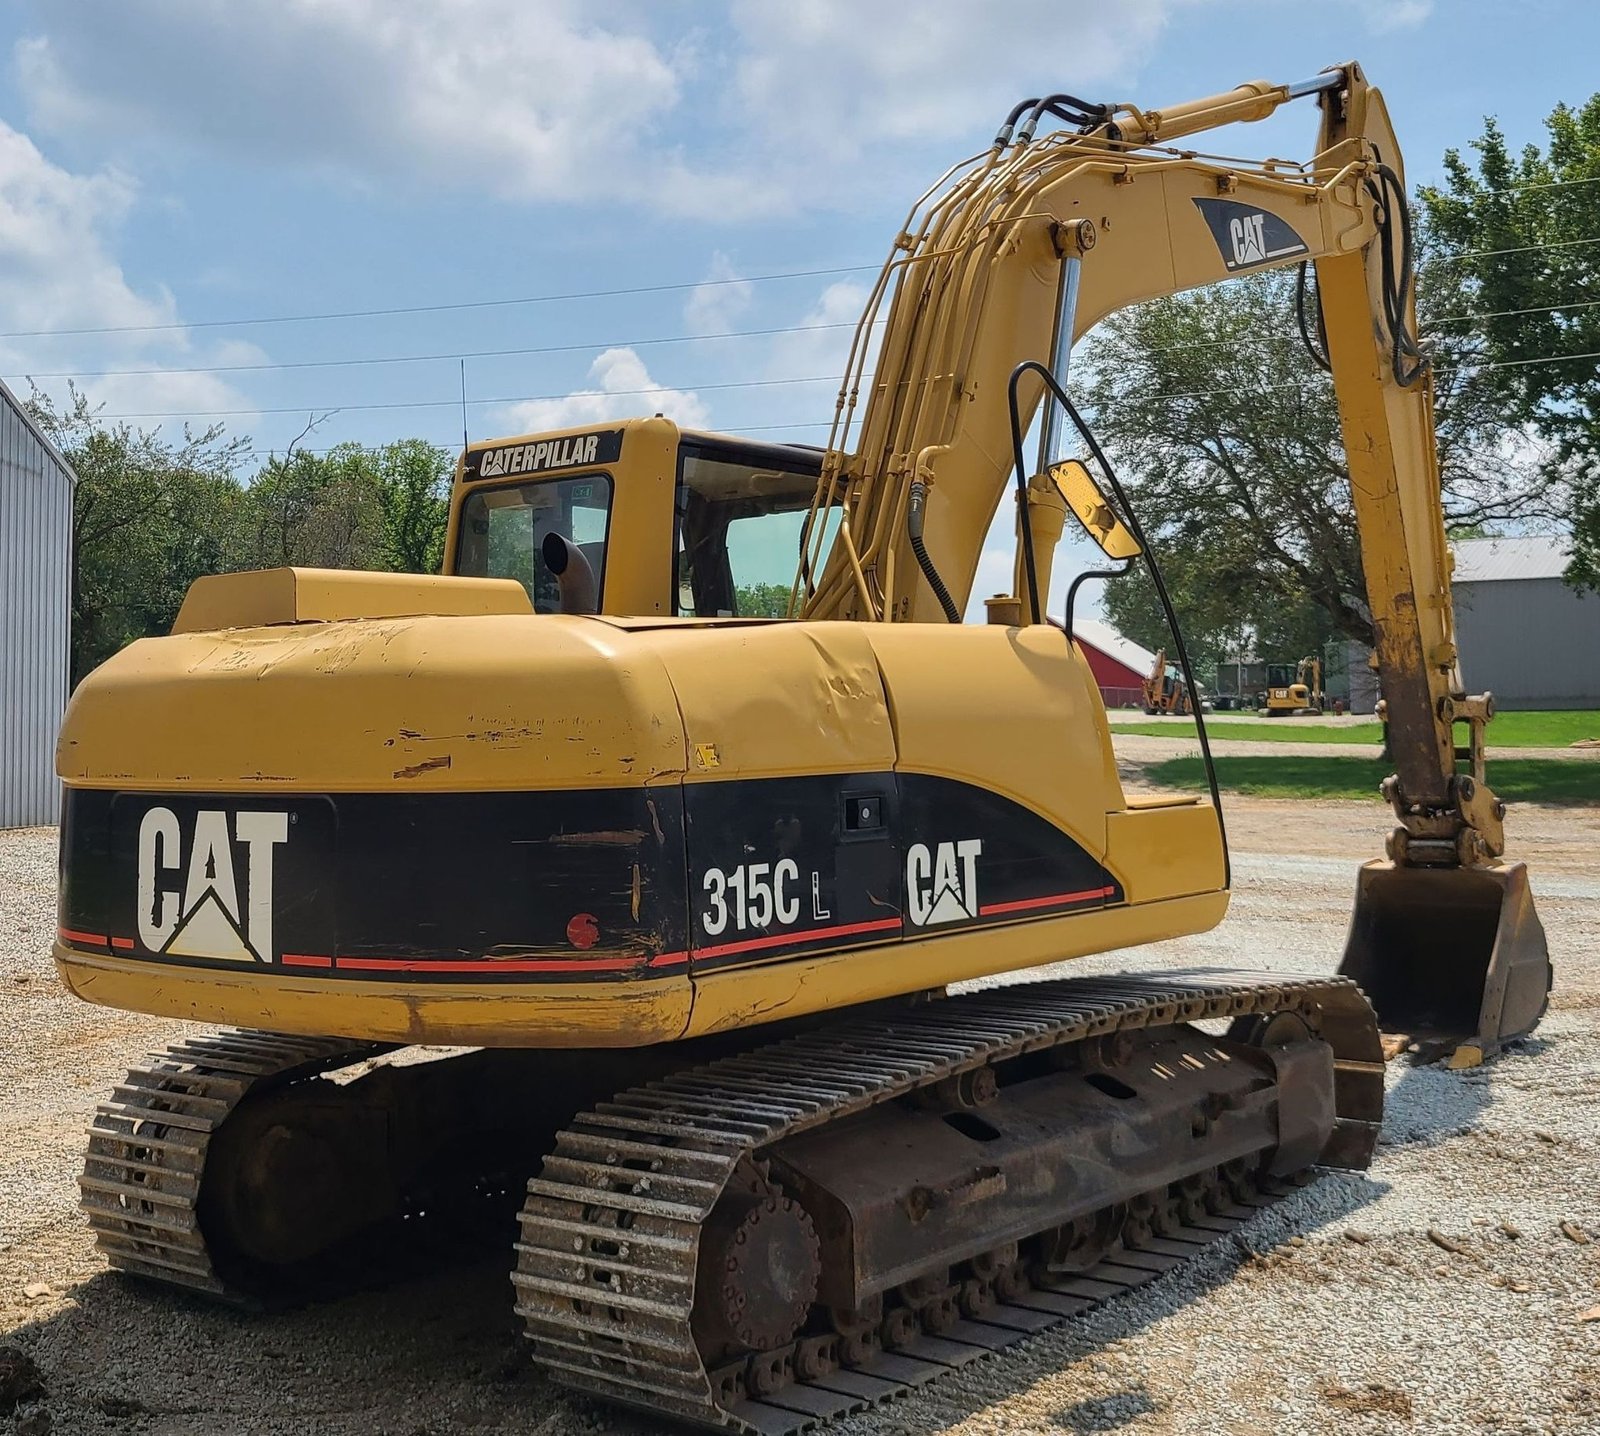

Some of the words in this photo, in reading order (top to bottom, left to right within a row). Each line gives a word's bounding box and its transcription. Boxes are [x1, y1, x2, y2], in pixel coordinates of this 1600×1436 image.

[1231, 214, 1265, 264] CAT
[481, 435, 599, 477] CATERPILLAR
[1275, 690, 1288, 698] CAT
[138, 806, 288, 963] CAT
[702, 858, 799, 937] 315C
[811, 871, 830, 920] L
[907, 839, 982, 926] CAT
